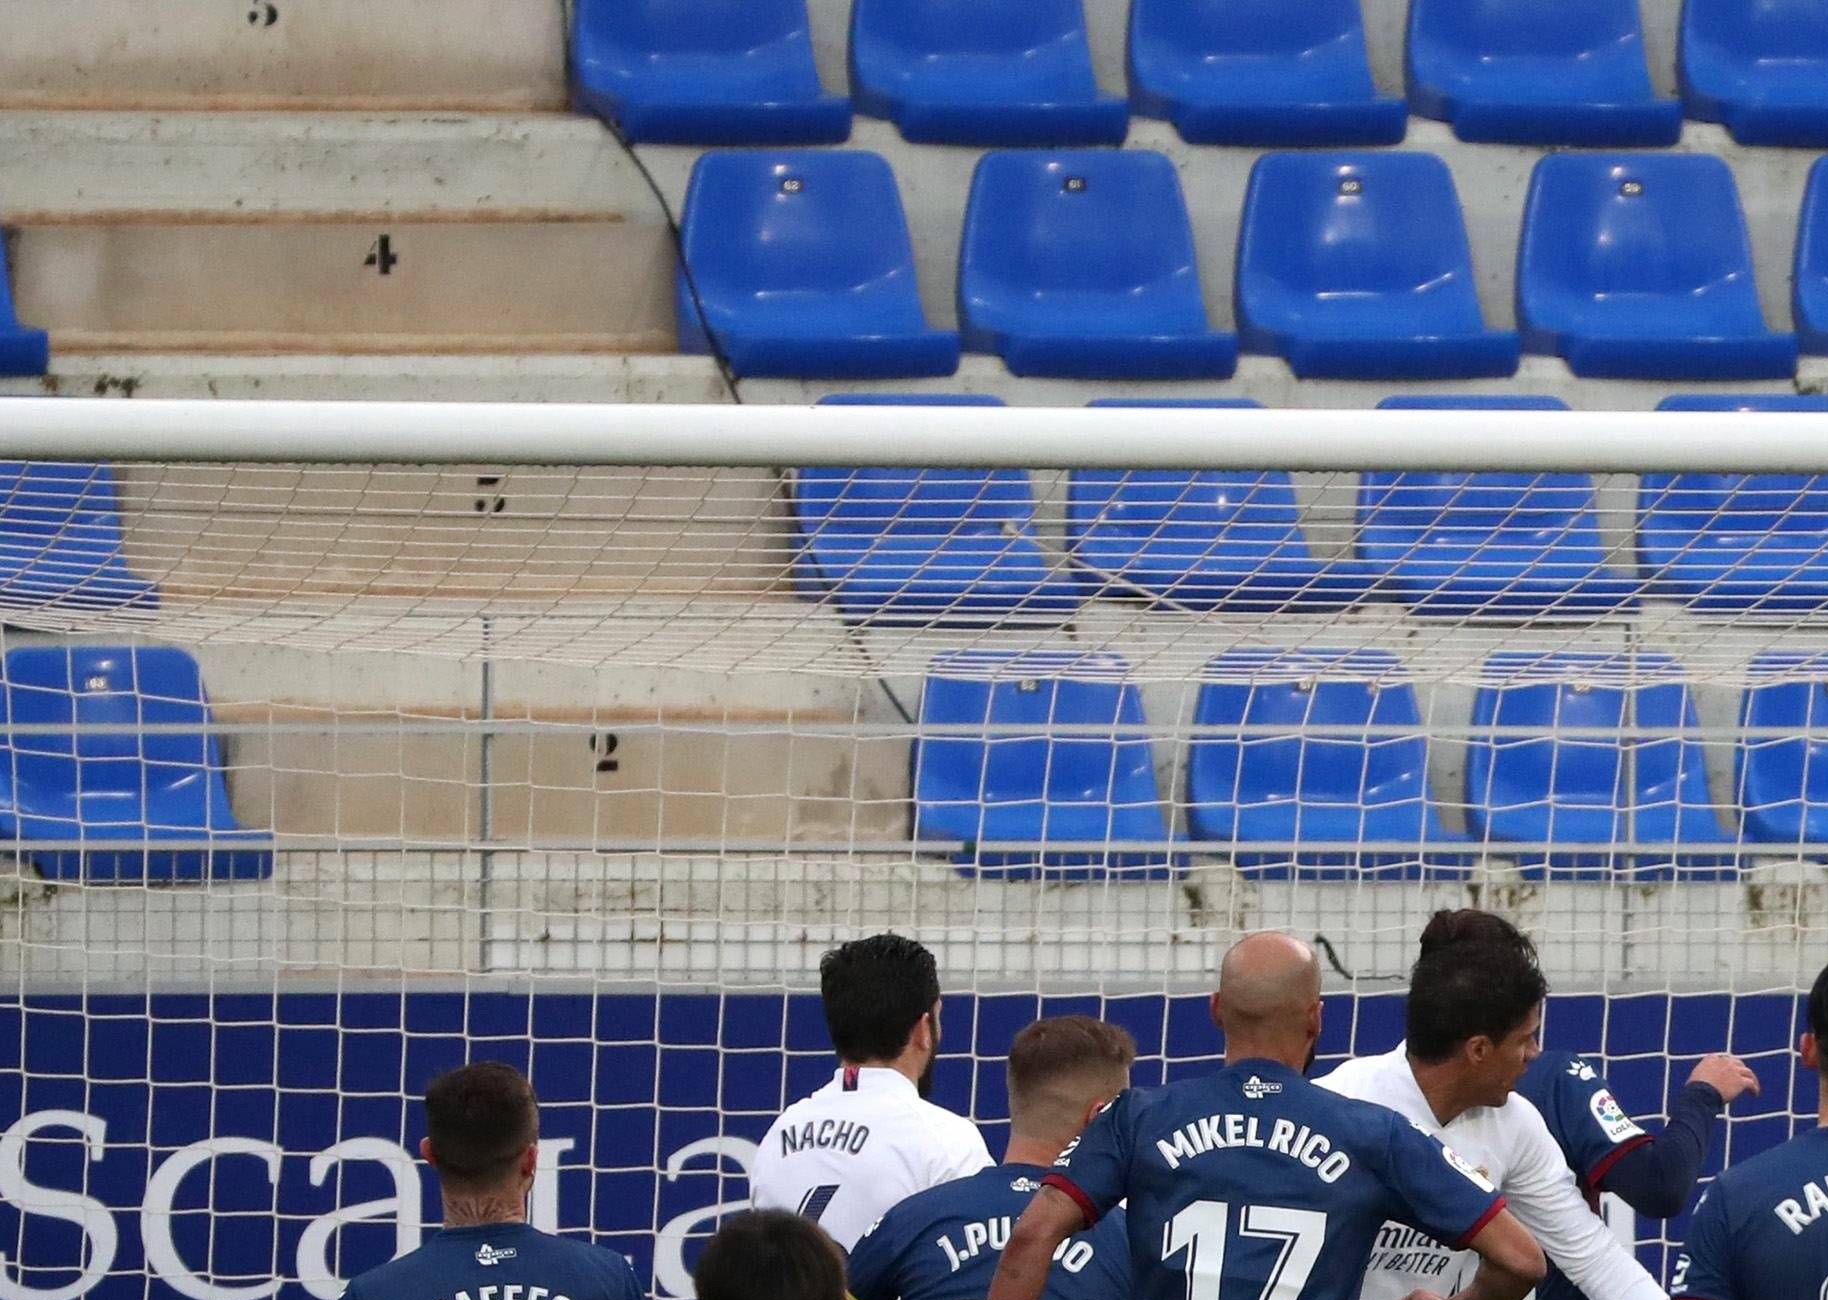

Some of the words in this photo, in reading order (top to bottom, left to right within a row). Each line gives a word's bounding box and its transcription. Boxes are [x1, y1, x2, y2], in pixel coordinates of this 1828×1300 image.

[364, 234, 398, 275] 4
[780, 1119, 870, 1157] NACHO
[1156, 1113, 1265, 1170] MIKEL
[1267, 1116, 1352, 1184] RICO
[1384, 1252, 1451, 1276] BETTER
